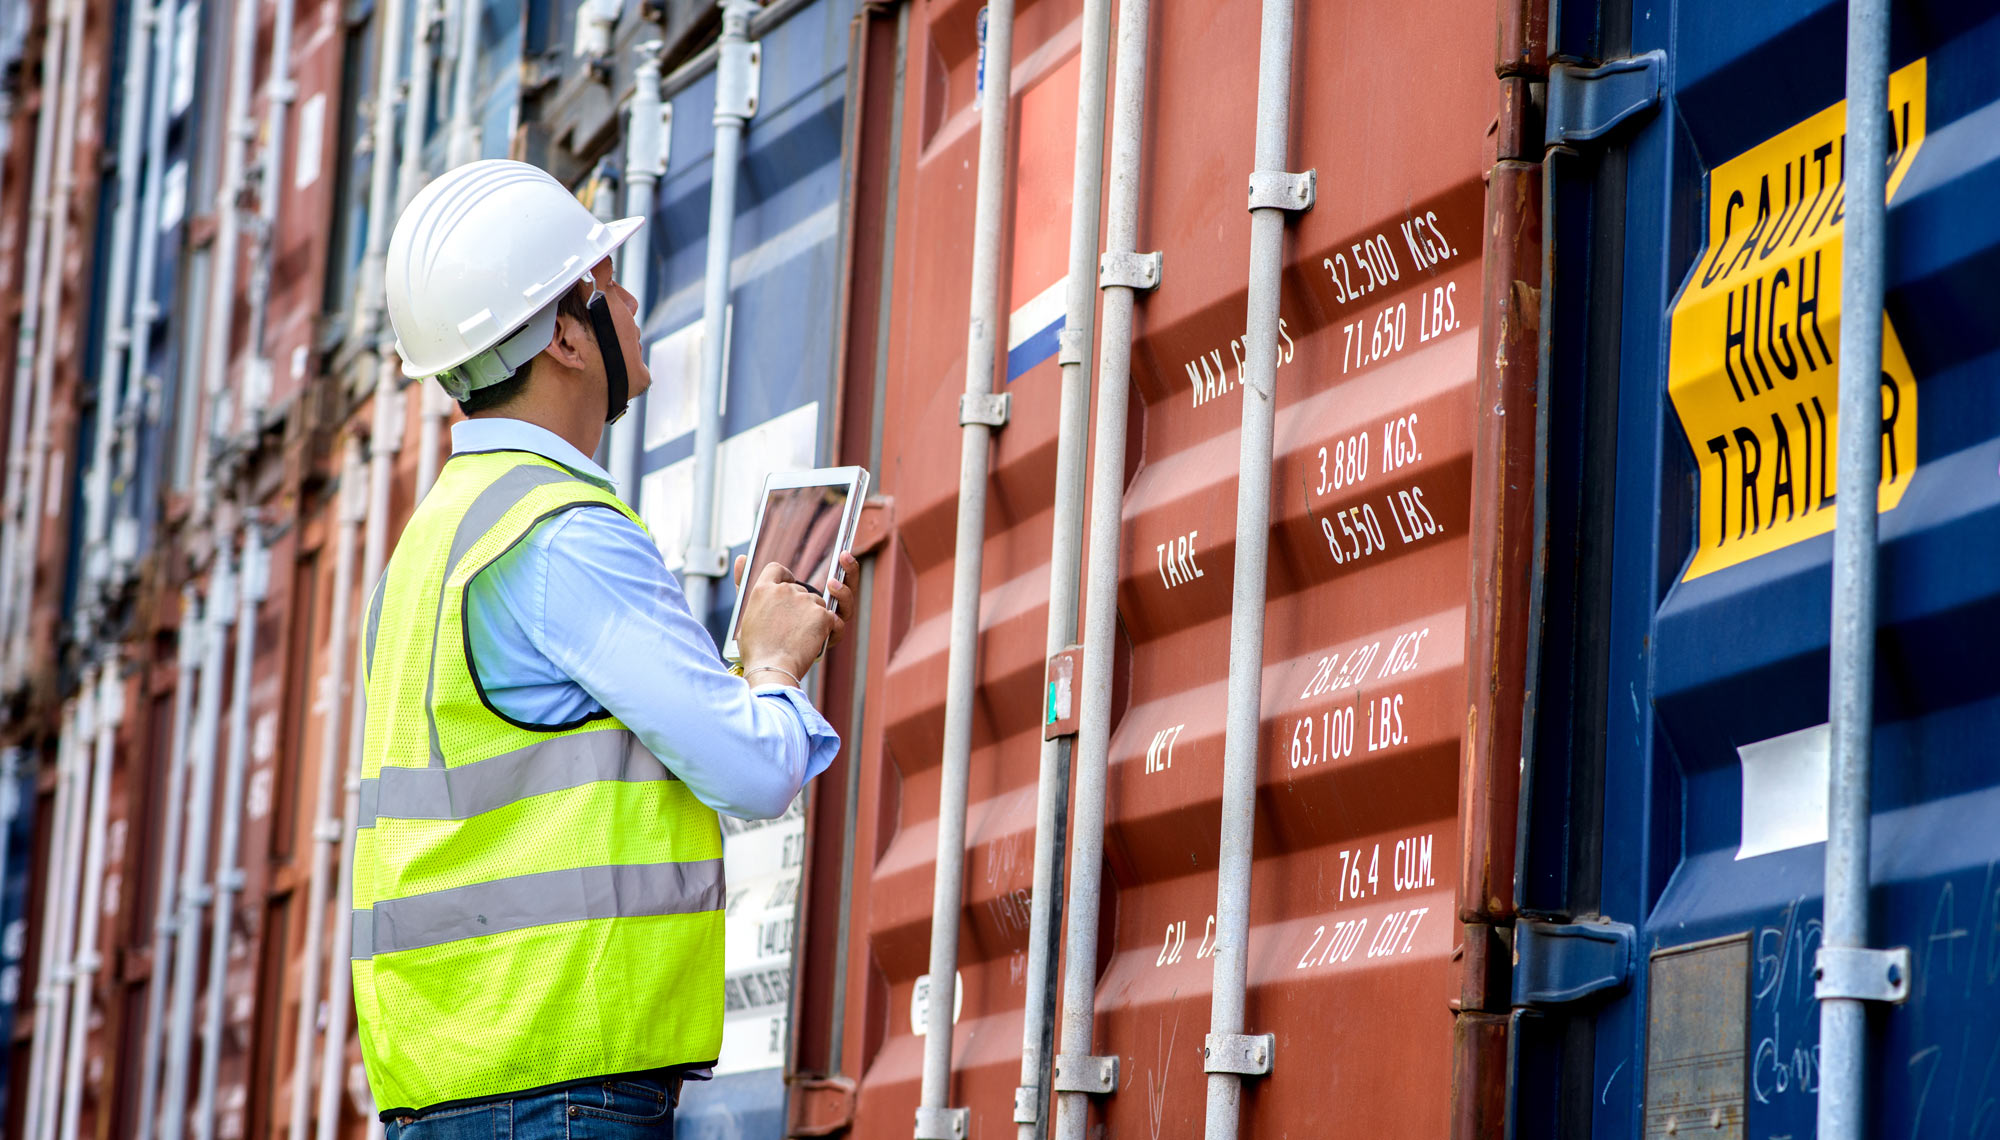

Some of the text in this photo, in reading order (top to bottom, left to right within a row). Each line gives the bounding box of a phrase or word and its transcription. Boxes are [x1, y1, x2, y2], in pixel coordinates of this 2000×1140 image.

[1701, 101, 1909, 288] CAUTIN
[1400, 210, 1458, 272] KGS.
[1343, 281, 1460, 374] 71,650 LBS.
[1725, 250, 1833, 402] HIGH
[1316, 412, 1423, 496] 3,880 KGS.
[1706, 370, 1900, 548] TRAILR
[1386, 486, 1445, 545] LBS.
[1156, 530, 1204, 590] TARE
[1377, 627, 1430, 680] KGS.
[1145, 723, 1185, 775] NET
[1290, 693, 1409, 769] 63,100 LBS.
[1338, 833, 1435, 902] 76.4 CU.M.
[1156, 920, 1187, 968] CU.
[1296, 917, 1368, 969] 2,700
